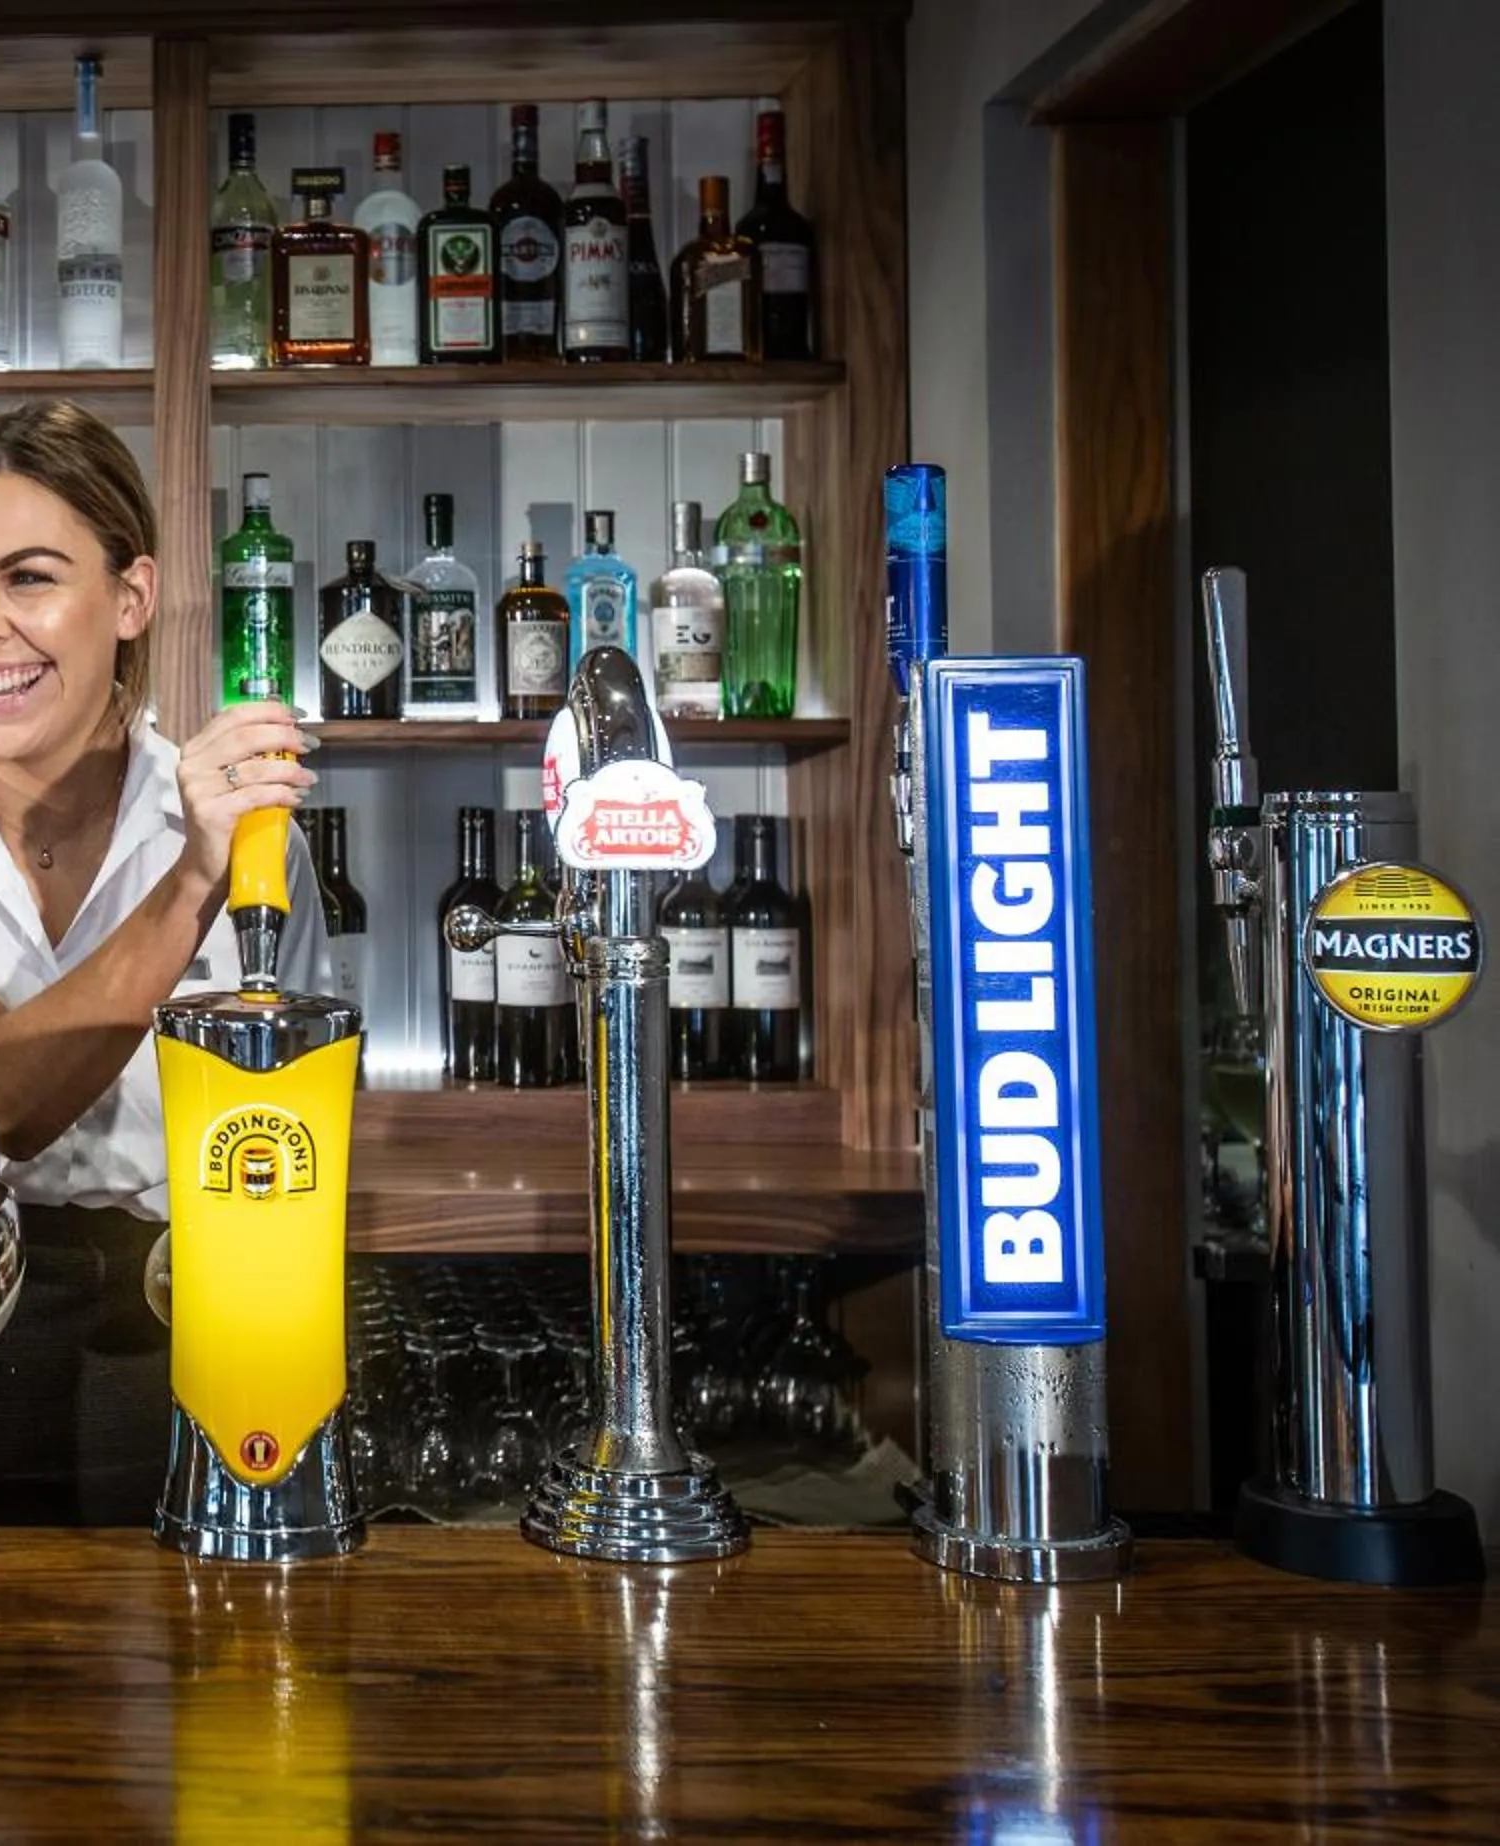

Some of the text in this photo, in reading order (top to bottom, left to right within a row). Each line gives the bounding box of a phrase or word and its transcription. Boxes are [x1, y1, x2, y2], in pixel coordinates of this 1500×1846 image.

[594, 809, 680, 827] STELLA
[593, 828, 681, 846] ARTOIS
[1358, 902, 1395, 911] SINCE
[1313, 929, 1472, 961] MAGNERS
[967, 710, 1064, 1284] BUD LIGHT
[1349, 987, 1440, 1002] ORIGINAL
[1358, 1003, 1429, 1013] IRISH CIDER
[209, 1112, 309, 1174] BODDINGTONS
